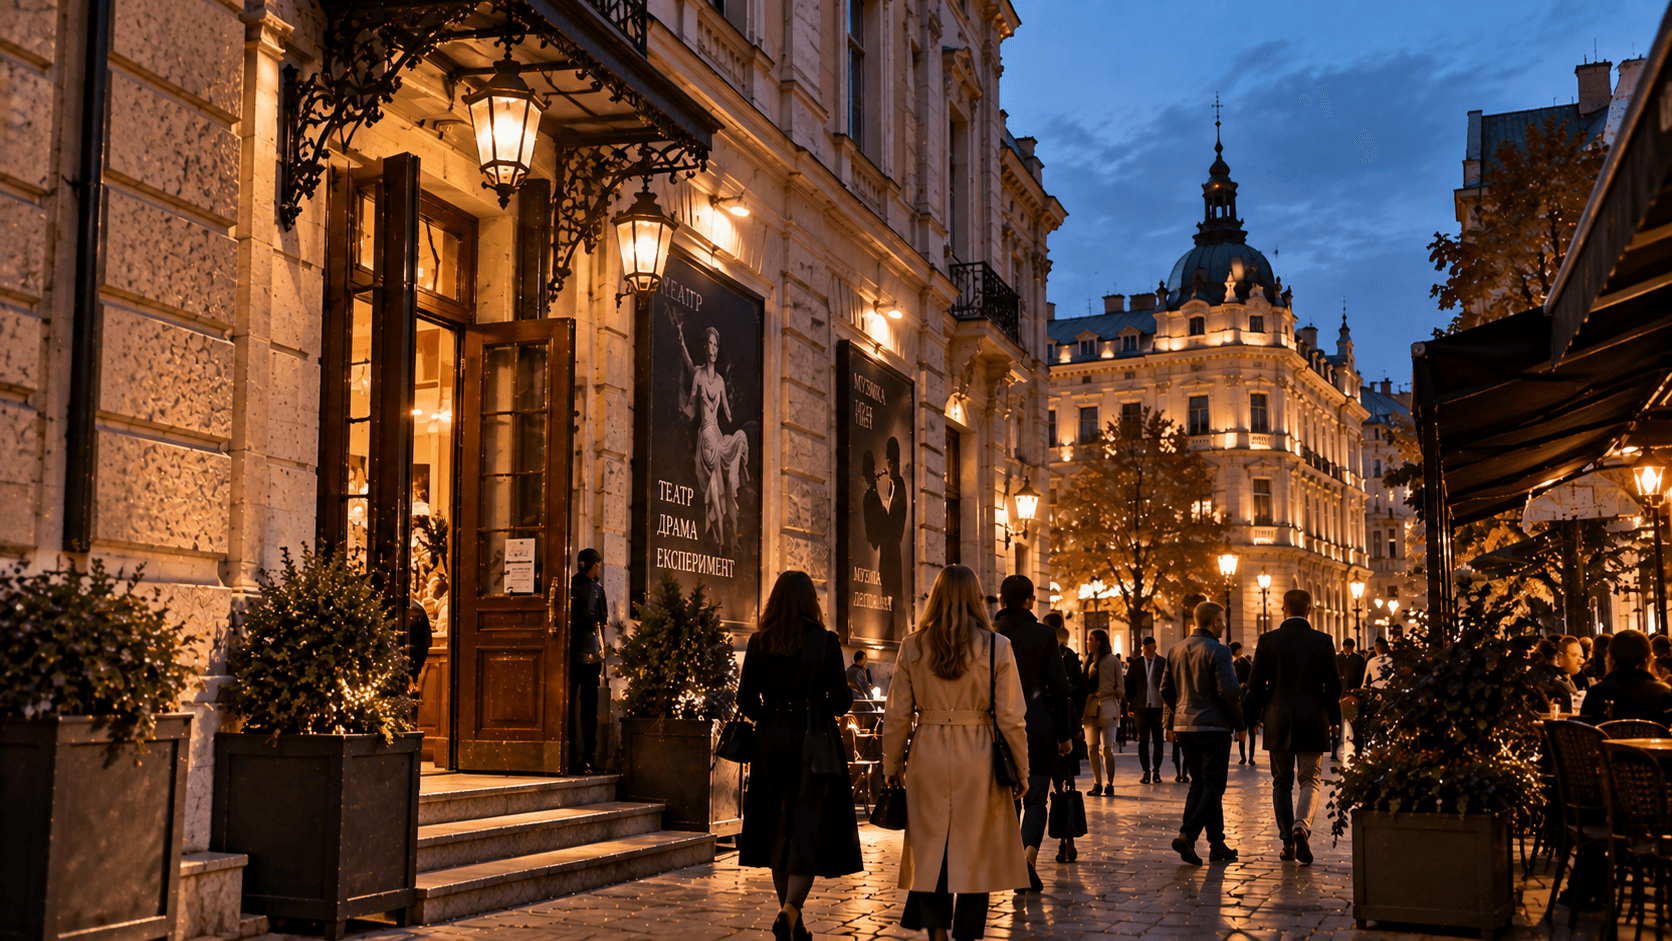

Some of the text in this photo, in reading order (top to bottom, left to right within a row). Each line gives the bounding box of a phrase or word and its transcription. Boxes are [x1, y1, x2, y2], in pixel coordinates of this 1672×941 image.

[658, 479, 694, 507] ТЕАТР
[656, 513, 699, 541] ДРАМА
[656, 547, 736, 578] ЕКСПЕРИМЕНТ
